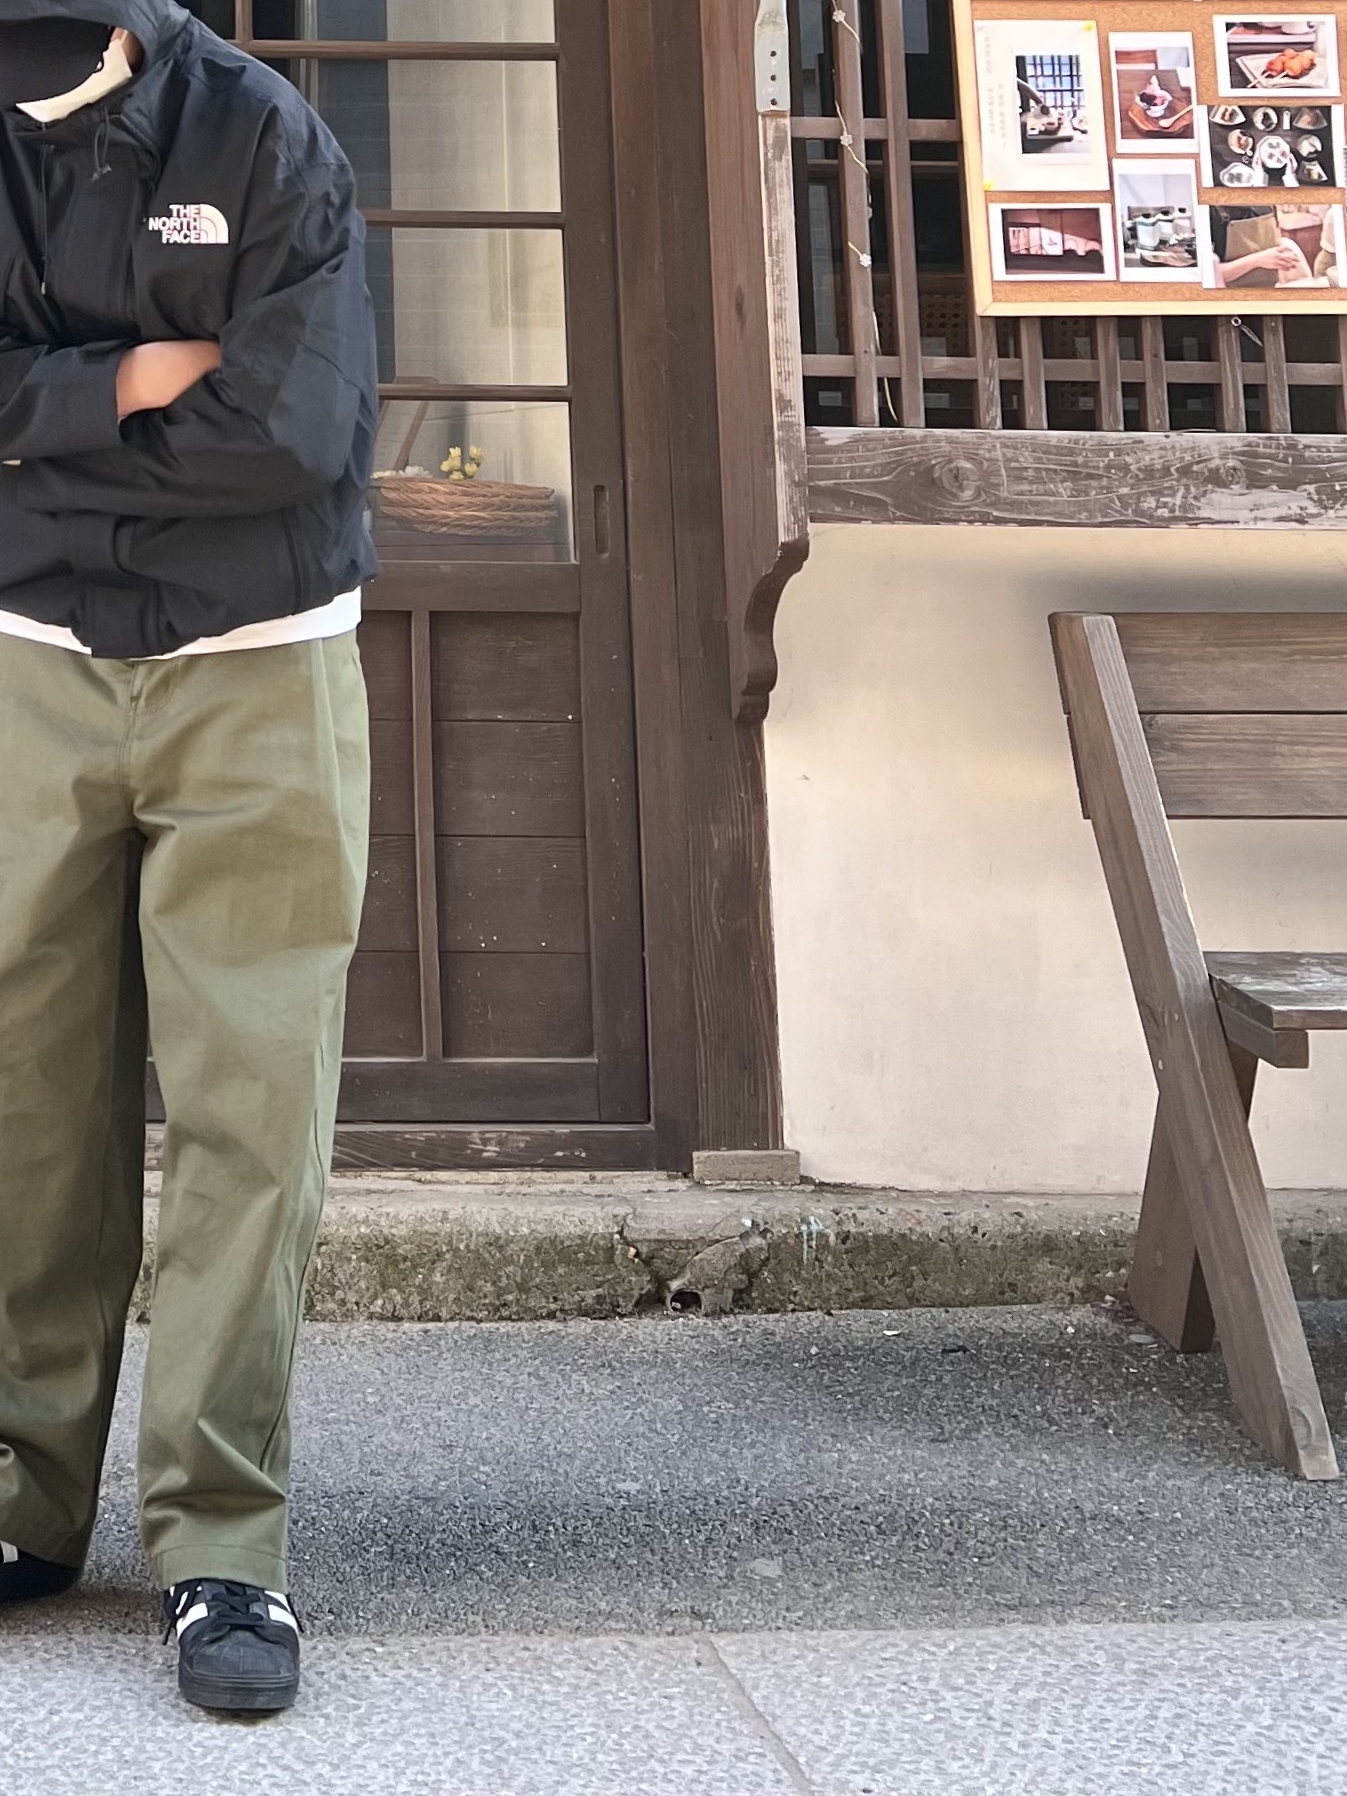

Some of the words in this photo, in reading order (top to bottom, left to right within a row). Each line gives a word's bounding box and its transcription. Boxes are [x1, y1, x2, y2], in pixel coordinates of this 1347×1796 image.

[169, 204, 200, 217] THE
[148, 217, 200, 231] NORTH
[162, 230, 201, 244] FACE
